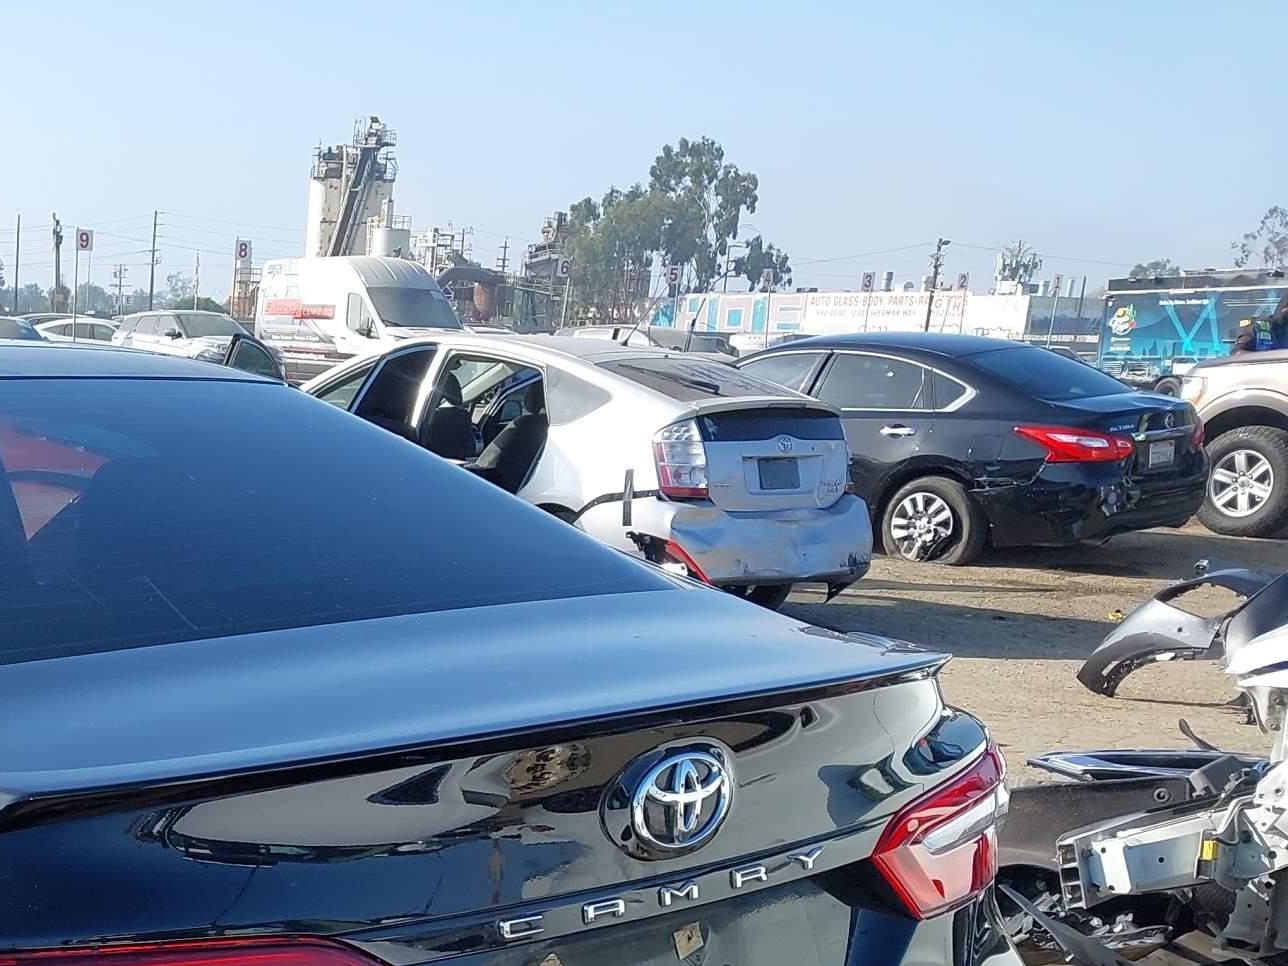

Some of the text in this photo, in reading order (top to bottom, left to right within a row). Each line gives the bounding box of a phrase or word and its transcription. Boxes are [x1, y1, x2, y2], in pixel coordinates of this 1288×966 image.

[79, 232, 90, 248] 9
[238, 242, 249, 258] 8
[560, 260, 570, 275] 6
[669, 267, 678, 282] 5
[764, 272, 772, 284] 4
[863, 274, 873, 288] 3
[959, 274, 968, 288] 2
[811, 295, 831, 307] AUTO
[834, 295, 859, 307] GLASS
[862, 295, 883, 307] BODY
[888, 295, 914, 307] PARTS
[498, 846, 824, 938] CAMRY
